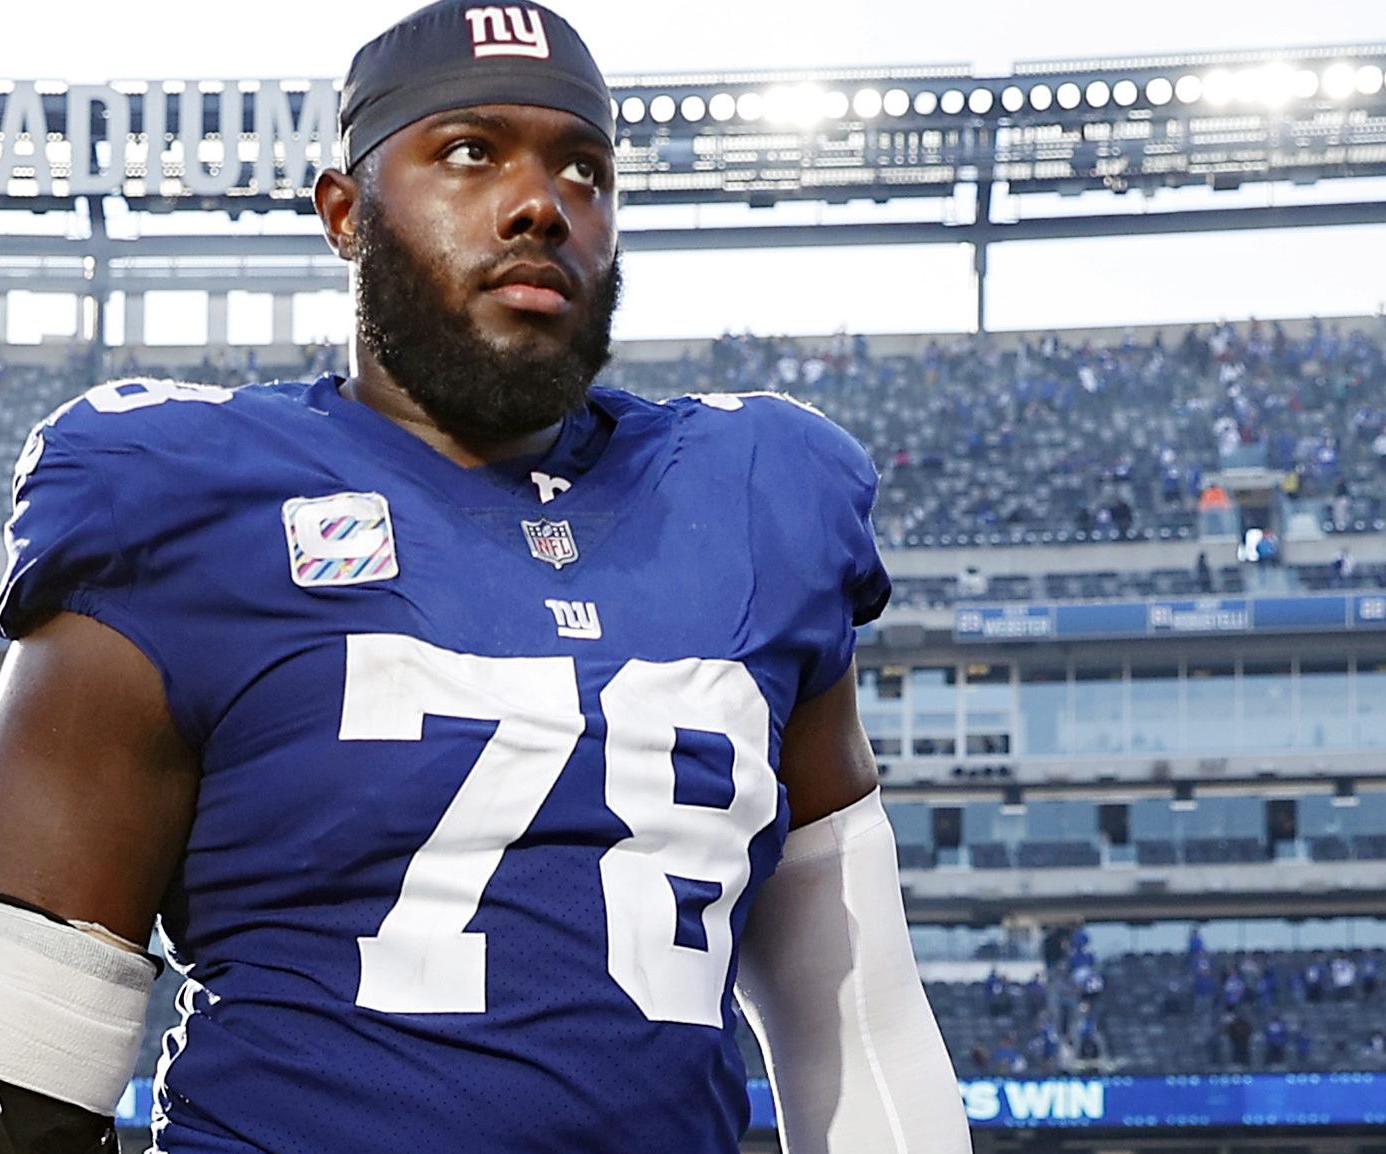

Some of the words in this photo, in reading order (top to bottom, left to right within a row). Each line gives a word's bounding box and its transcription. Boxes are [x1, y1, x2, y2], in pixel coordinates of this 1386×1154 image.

[537, 538, 571, 556] NFL
[339, 633, 778, 1027] 78
[1004, 1081, 1104, 1119] WIN
